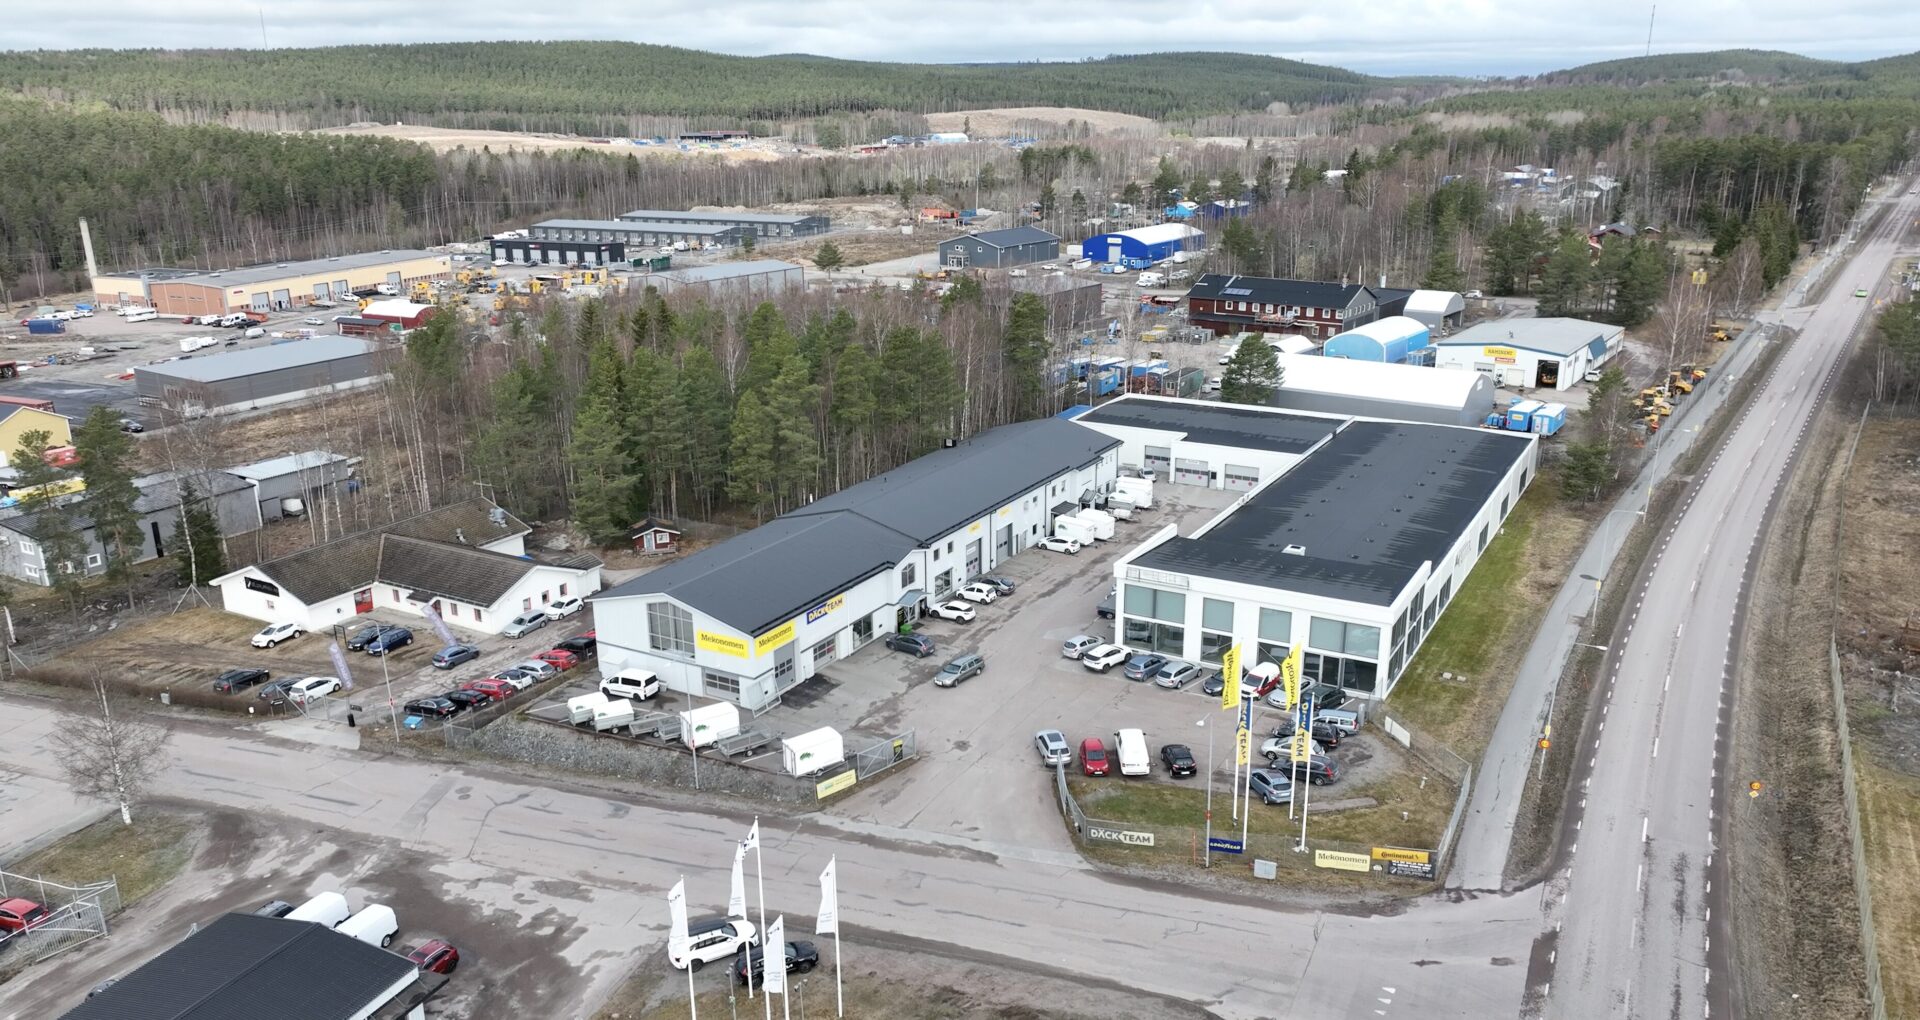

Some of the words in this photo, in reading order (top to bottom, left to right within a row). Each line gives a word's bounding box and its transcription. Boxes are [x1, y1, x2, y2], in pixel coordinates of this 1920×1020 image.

[808, 607, 826, 622] DÄCK
[827, 597, 843, 611] TEAM
[701, 633, 744, 650] Mekonomen
[758, 625, 792, 648] Mekonomen
[1296, 732, 1305, 757] TEAM
[1090, 828, 1119, 842] DÄCK
[1122, 833, 1151, 844] TEAM
[1317, 853, 1368, 865] Mekonomen
[1381, 852, 1416, 860] Continental
